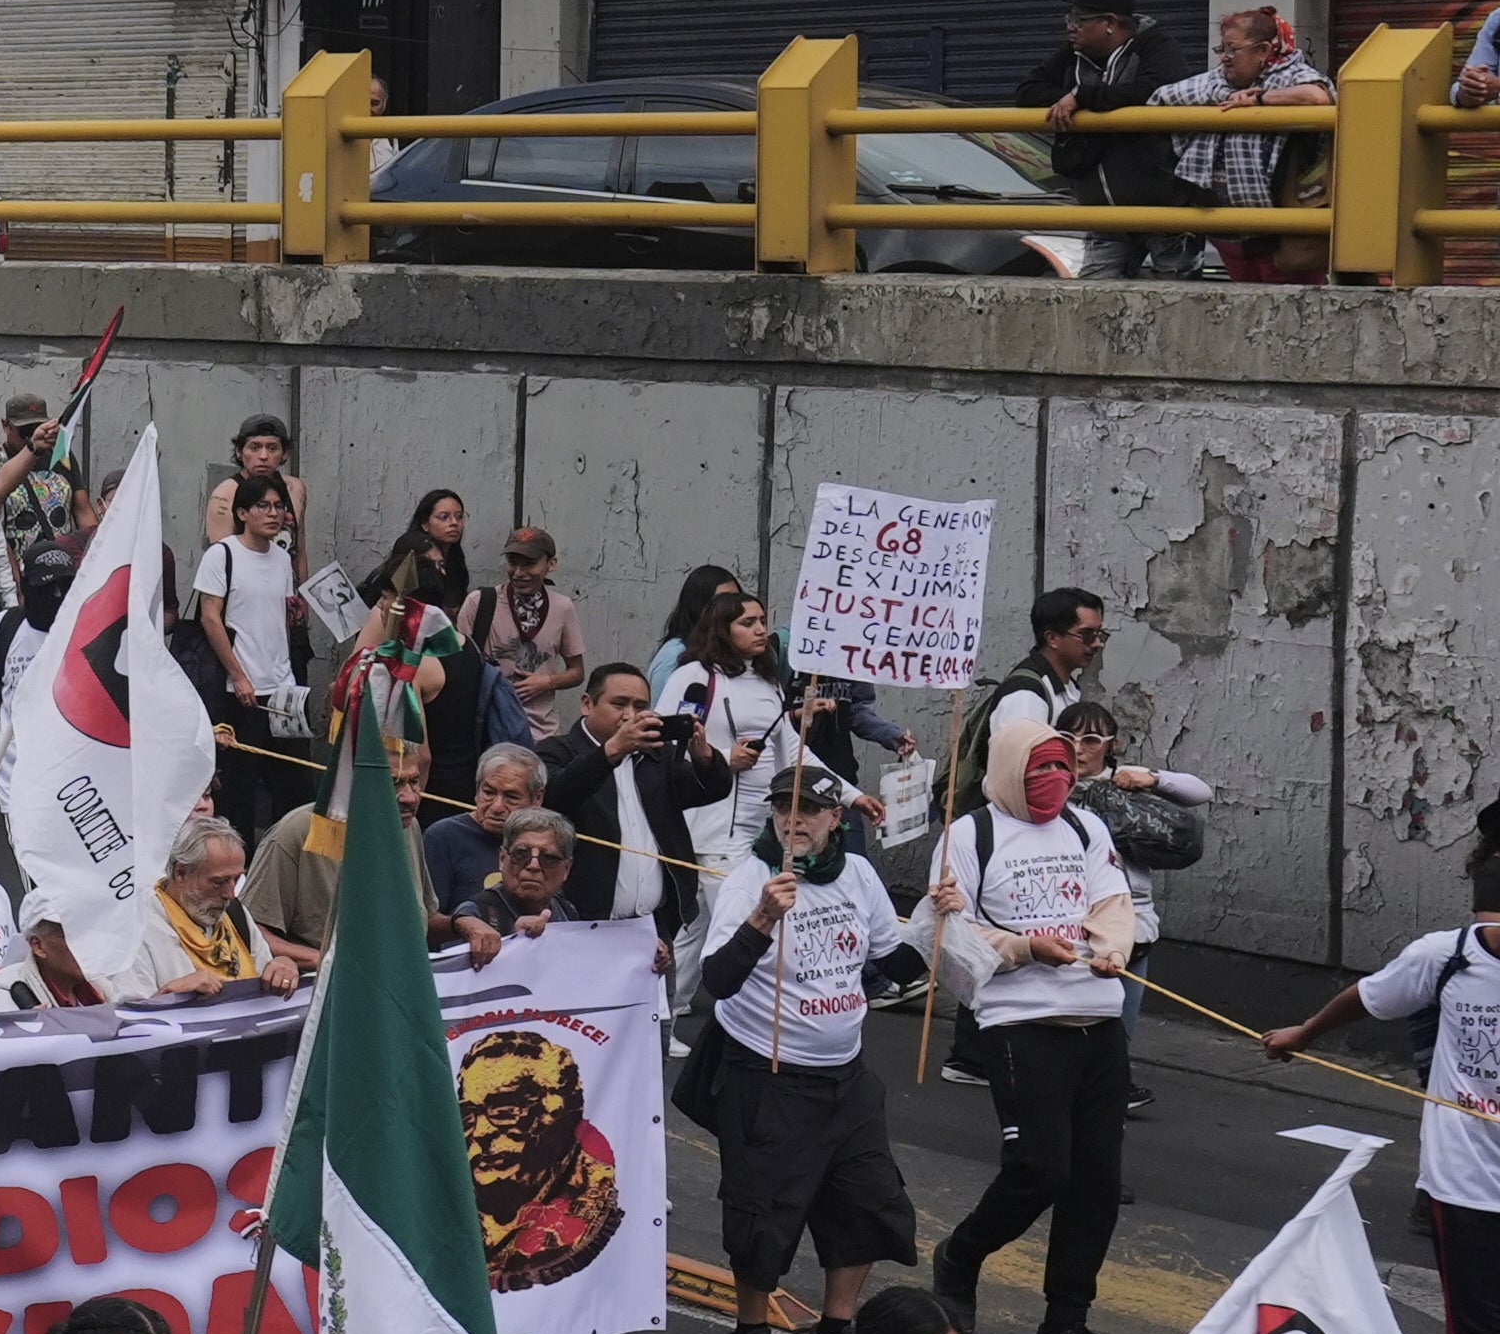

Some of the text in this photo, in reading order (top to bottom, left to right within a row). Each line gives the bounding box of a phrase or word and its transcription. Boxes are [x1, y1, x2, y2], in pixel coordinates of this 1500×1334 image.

[821, 521, 922, 555] DEL 68
[798, 638, 827, 656] DE
[56, 775, 134, 864] COMITÉ
[796, 969, 823, 984] GAZA
[446, 1008, 611, 1046] EMORIA FLORECE!
[1478, 1015, 1498, 1026] fue
